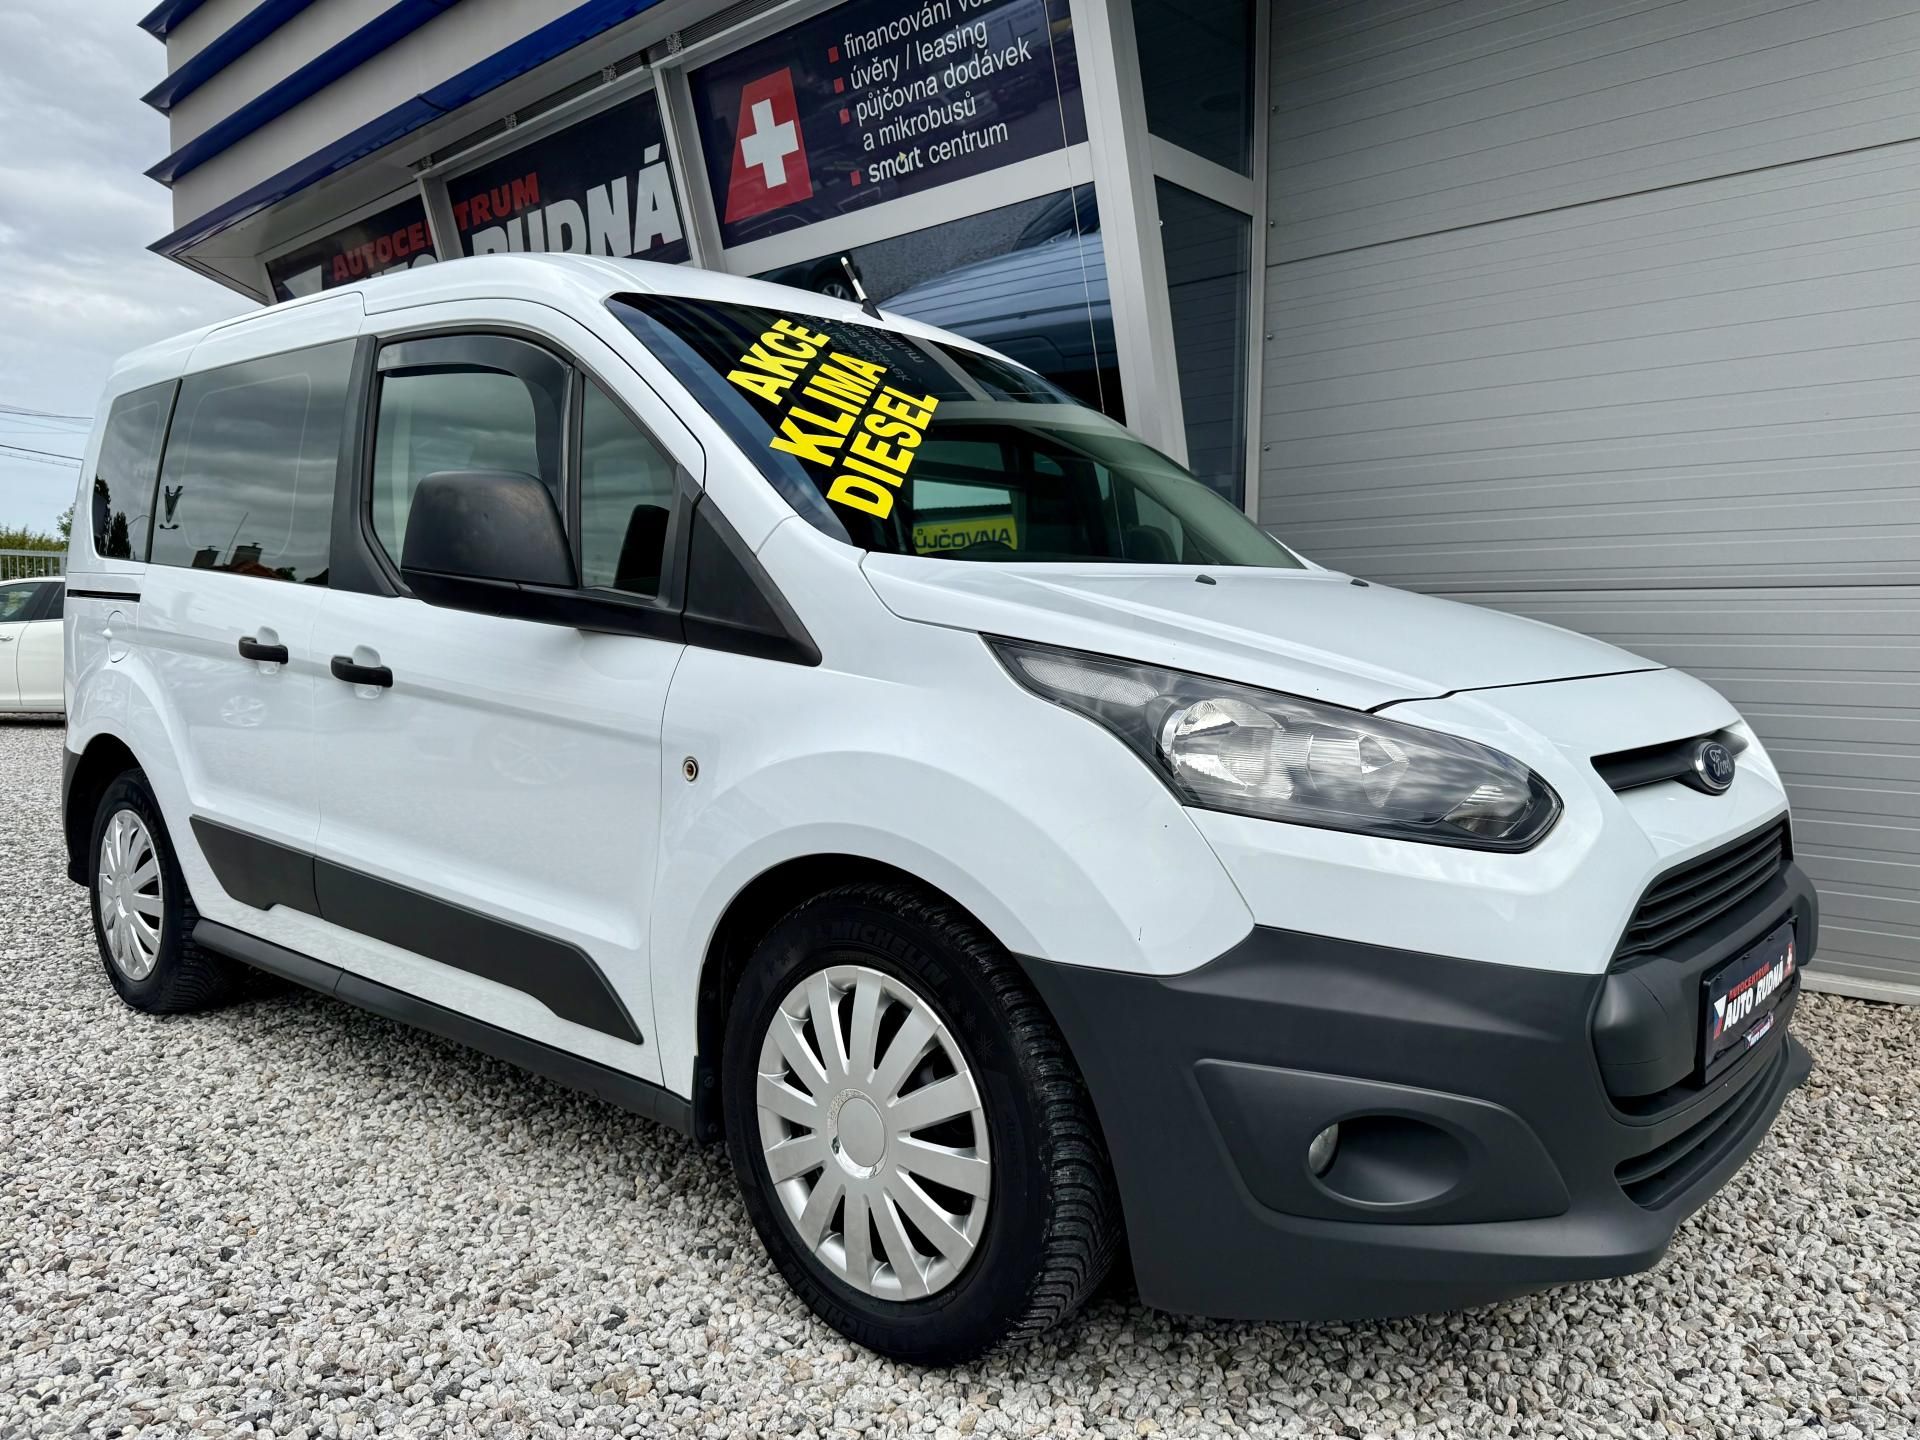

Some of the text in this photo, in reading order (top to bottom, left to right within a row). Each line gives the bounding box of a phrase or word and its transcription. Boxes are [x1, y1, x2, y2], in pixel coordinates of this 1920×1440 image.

[844, 0, 951, 59] financování
[850, 20, 988, 90] úvěry / leasing
[856, 37, 1032, 127] půjčovna dodávek
[863, 91, 977, 151] a mikrobusů
[868, 122, 1009, 183] smart centrum
[332, 172, 541, 282] AUTOCETRUM
[726, 318, 831, 406] AKCE
[769, 351, 888, 467] KLIMA
[826, 385, 940, 520] DIESEL
[1709, 749, 1732, 777] Ford
[1723, 987, 1754, 1032] AUTO
[1755, 955, 1784, 1006] RUDNÁ
[1728, 961, 1771, 1001] AUTOCENTRUM
